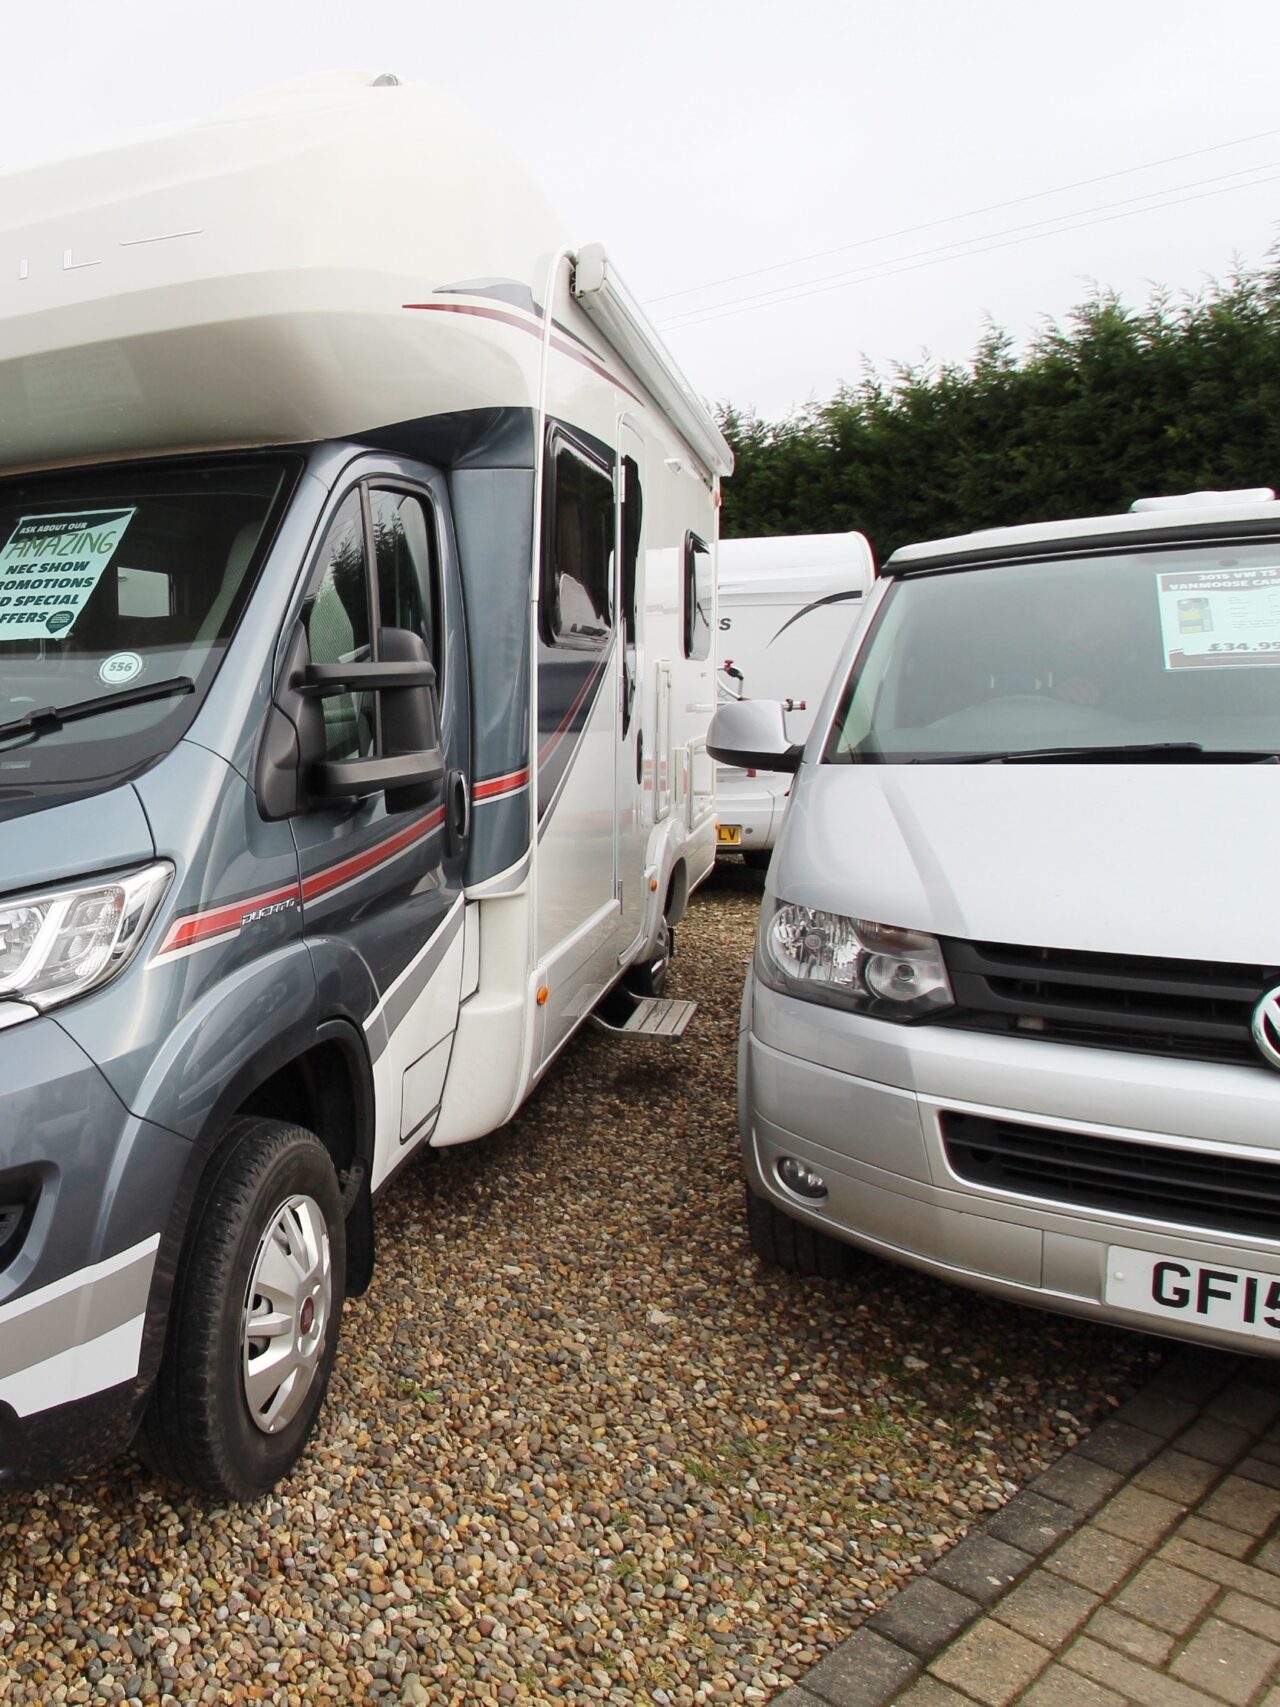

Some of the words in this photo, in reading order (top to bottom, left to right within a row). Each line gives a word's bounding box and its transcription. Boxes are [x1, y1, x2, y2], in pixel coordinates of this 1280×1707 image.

[19, 526, 37, 534] ASK
[37, 523, 67, 533] ABOUT
[68, 522, 88, 530] OUR
[4, 531, 117, 560] AMAZING
[5, 563, 37, 575] NEC
[38, 561, 91, 573] SHOW
[1197, 573, 1230, 581] 2015
[1261, 569, 1277, 577] T5
[1169, 580, 1249, 590] VANMOOSE
[13, 594, 80, 607] SPECIAL
[109, 662, 133, 671] 556
